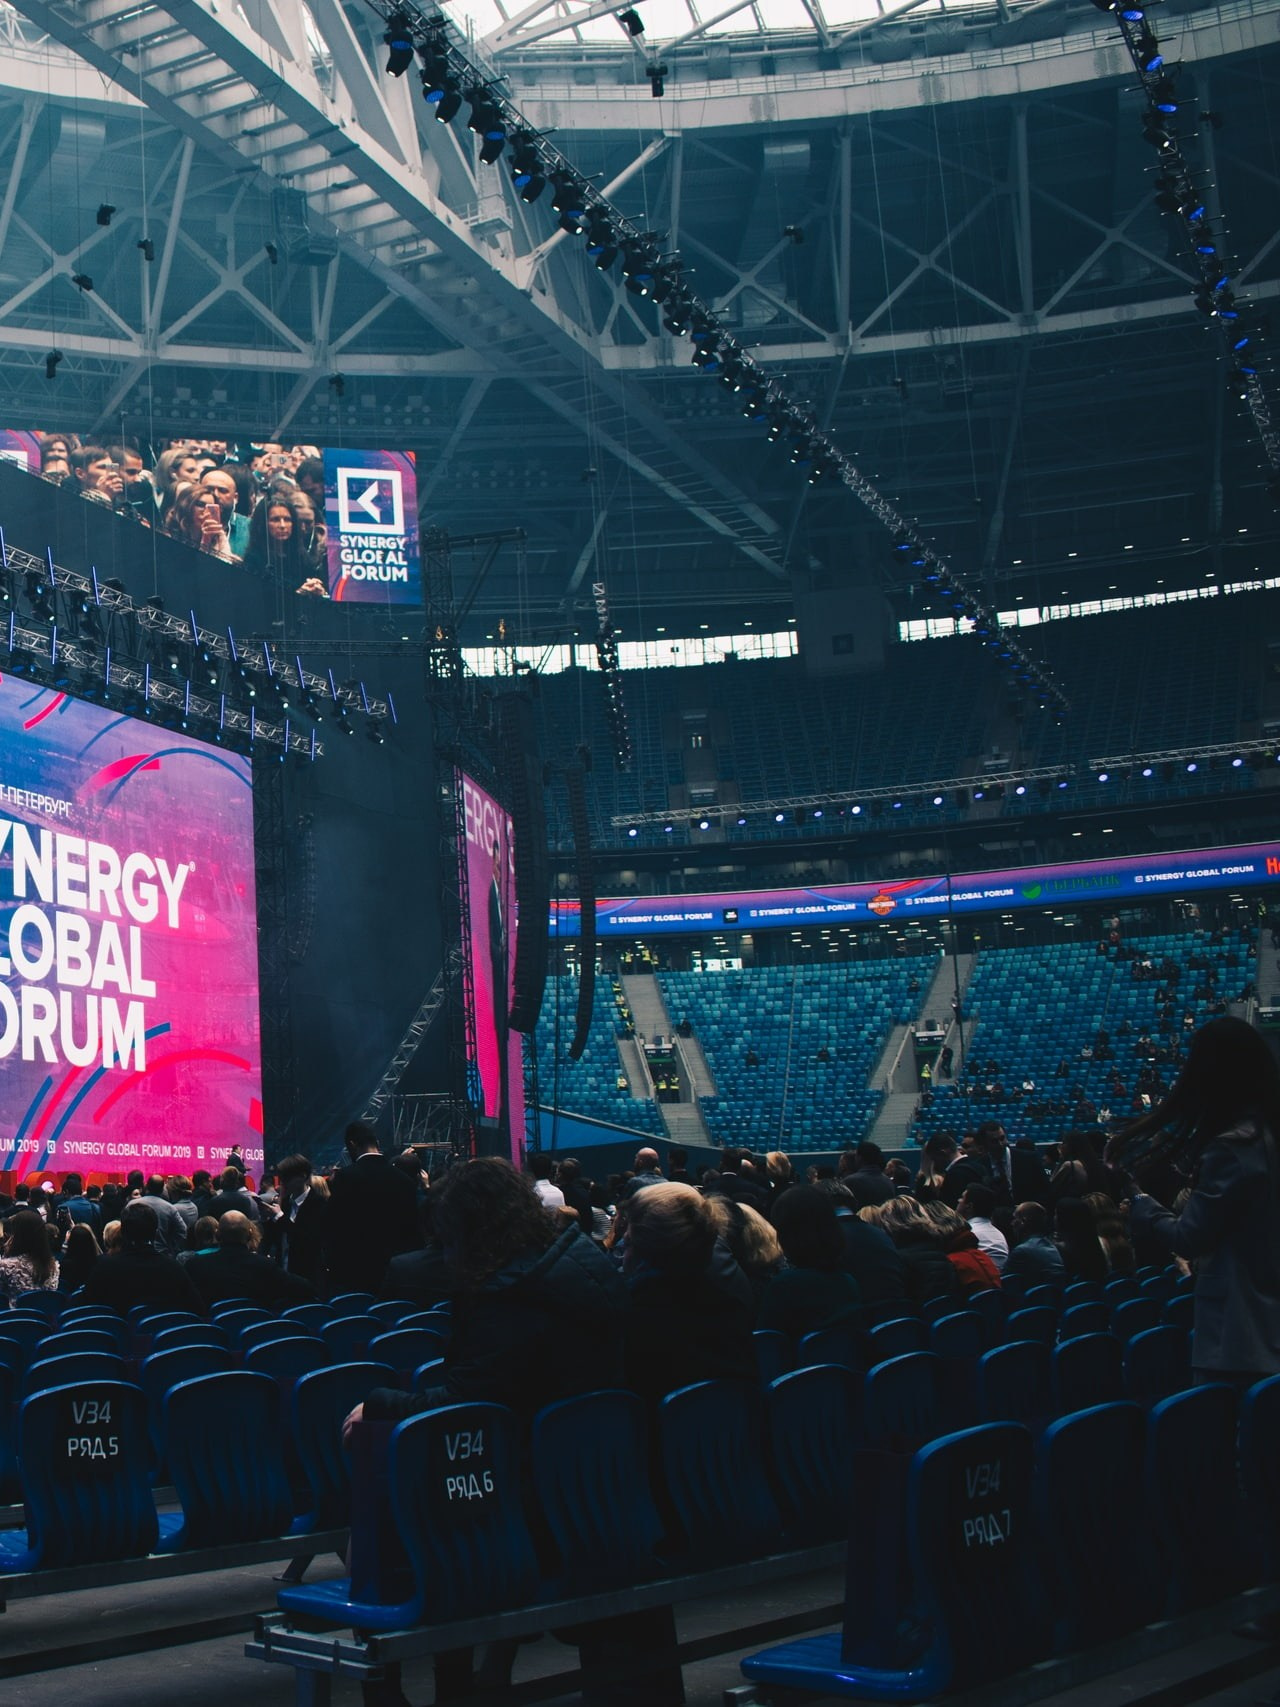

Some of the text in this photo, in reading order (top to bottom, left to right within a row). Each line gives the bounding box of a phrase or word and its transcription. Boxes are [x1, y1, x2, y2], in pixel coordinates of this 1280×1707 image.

[340, 535, 406, 550] SYNERGY
[341, 564, 408, 582] FORUM
[460, 780, 503, 866] ERGY
[1145, 865, 1254, 882] SYNERGY GLOBAL FORUM
[914, 889, 1014, 905] SYNERGY GLOBAL FORUM
[654, 914, 684, 922] GLOBAL
[685, 912, 713, 921] FORUM
[795, 906, 826, 914] GLOBAL
[827, 903, 856, 912] FORUM
[18, 1139, 40, 1153] 2019
[63, 1141, 105, 1156] SYNERGY
[107, 1143, 140, 1157] GLOBAL
[142, 1144, 171, 1158] FORUM
[173, 1145, 191, 1158] 2019
[72, 1400, 112, 1425] V34
[68, 1437, 119, 1460] РЯД 5
[445, 1429, 484, 1461] V34
[446, 1470, 494, 1500] РЯД 6
[963, 1508, 1011, 1547] РЯД 7
